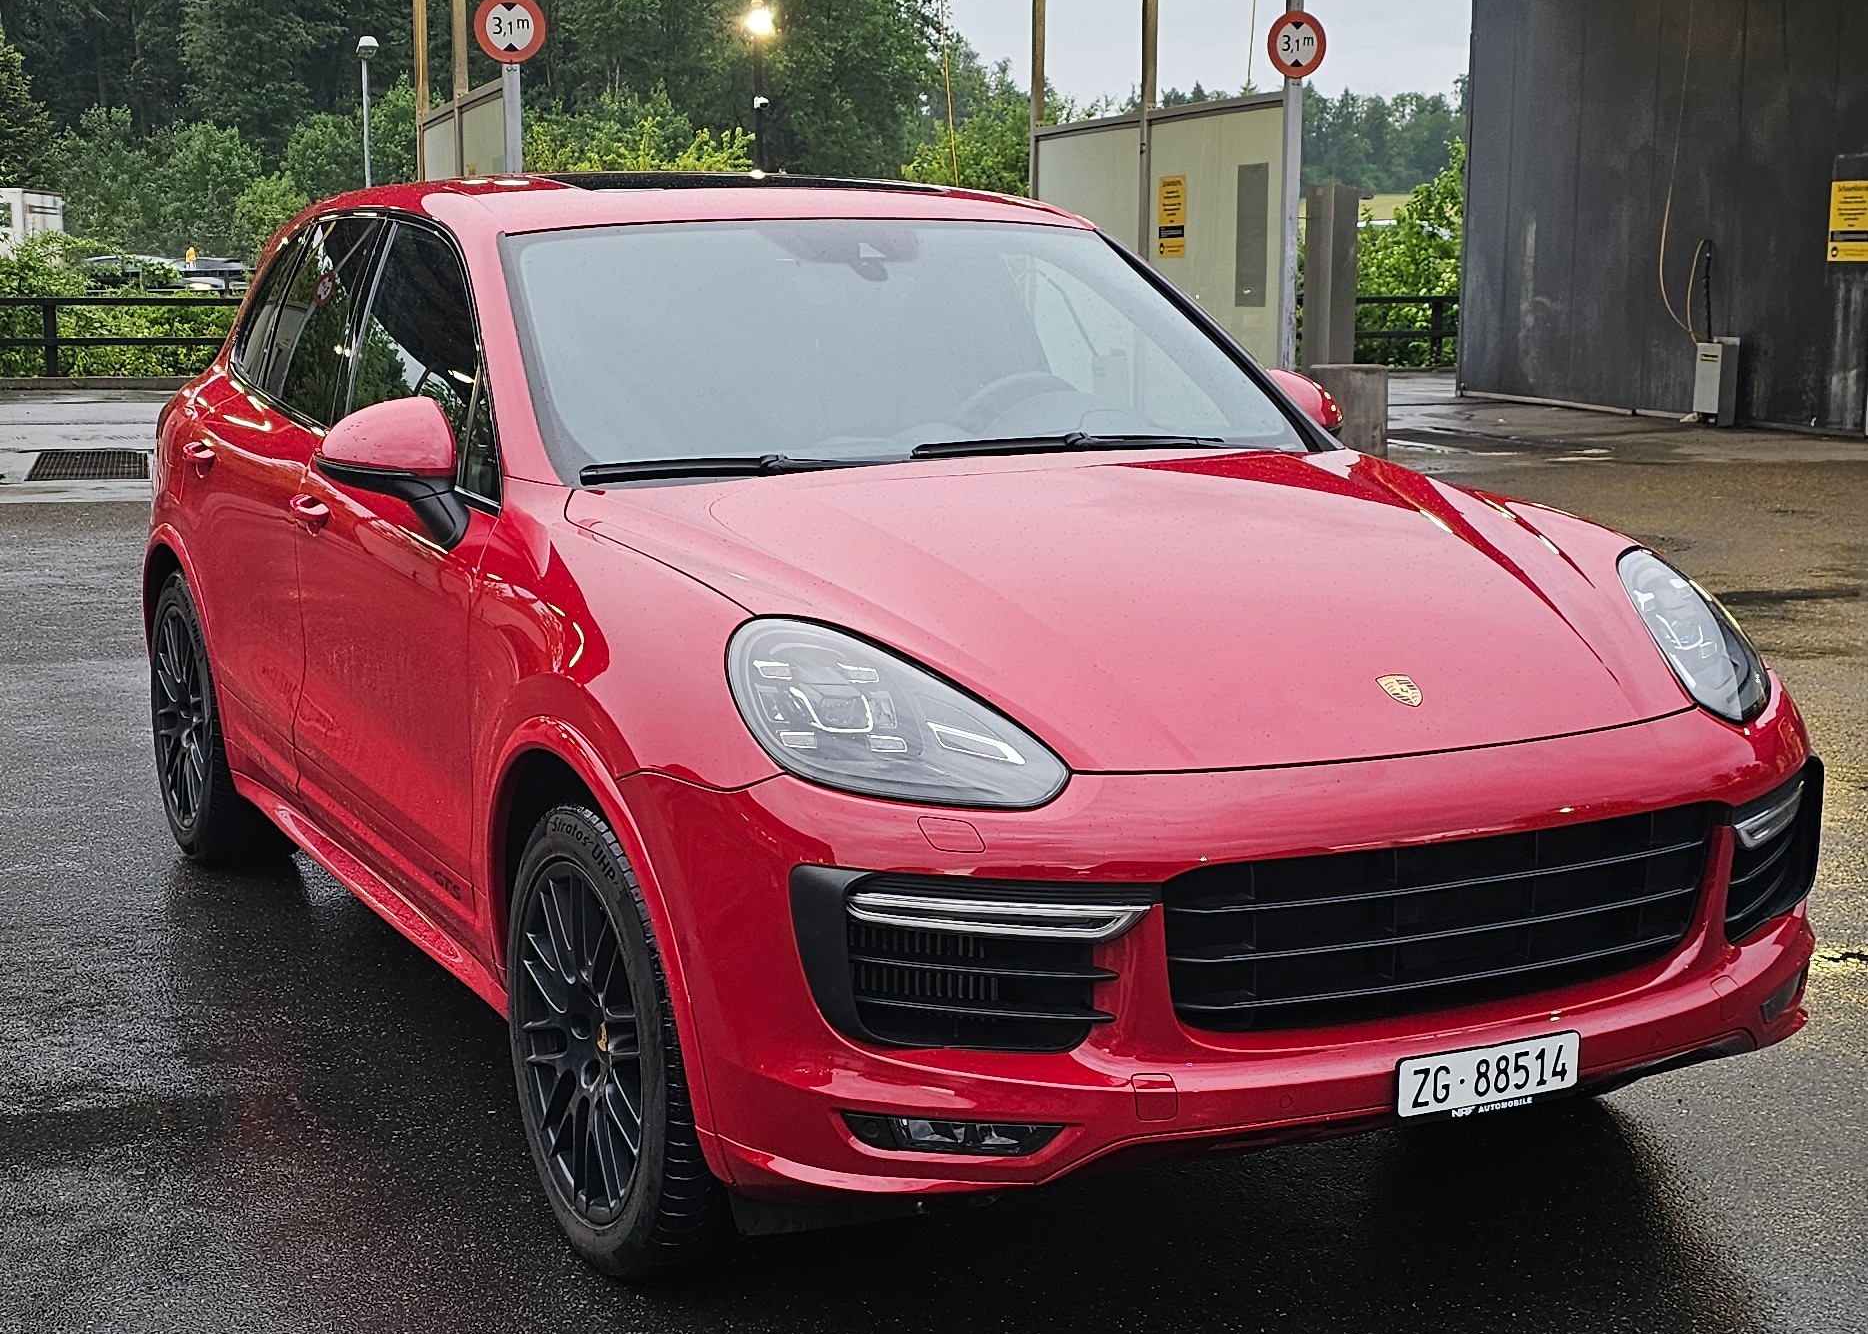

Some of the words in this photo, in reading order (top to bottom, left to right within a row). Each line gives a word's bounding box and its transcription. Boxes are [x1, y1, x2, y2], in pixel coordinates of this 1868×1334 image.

[551, 816, 590, 847] Stratos
[592, 843, 616, 881] UHP
[433, 870, 461, 901] GTS
[1478, 1096, 1533, 1114] AUTOMOBILE
